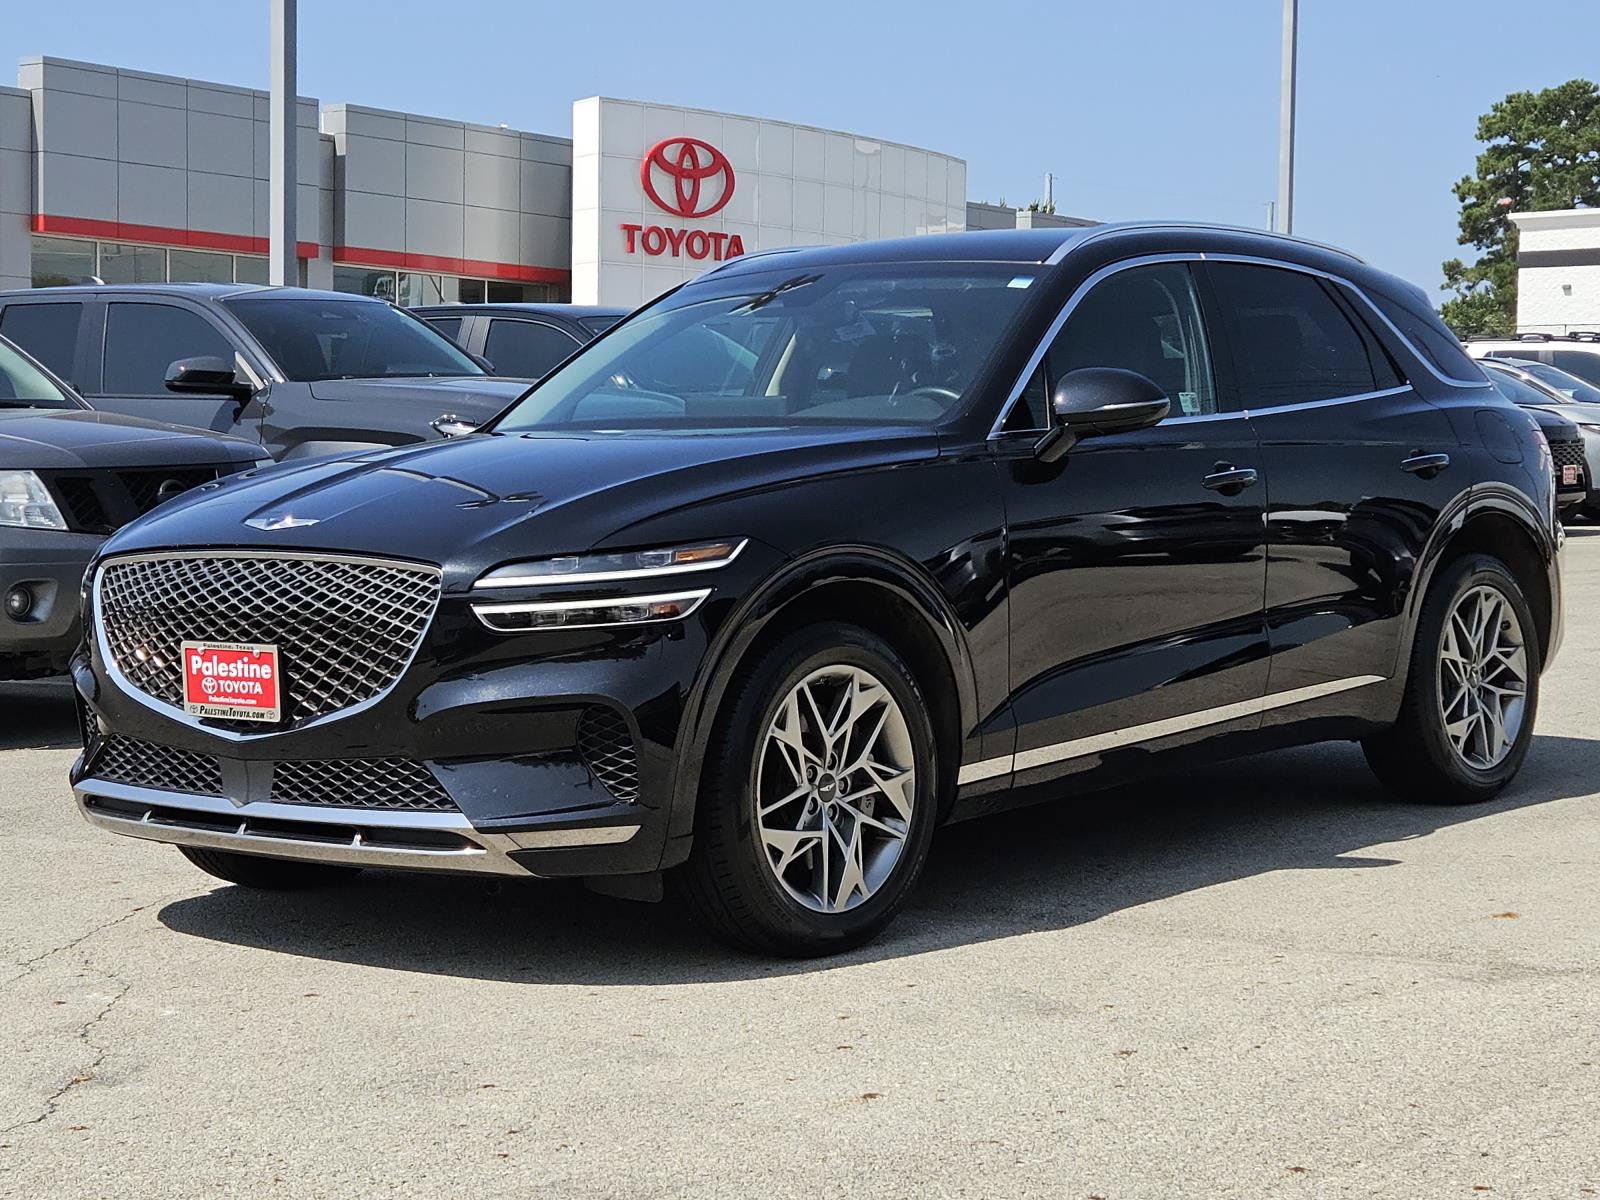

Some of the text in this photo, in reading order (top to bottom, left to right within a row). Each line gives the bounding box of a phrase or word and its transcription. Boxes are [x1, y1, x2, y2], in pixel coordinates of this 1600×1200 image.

[620, 223, 744, 261] TOYOTA
[191, 655, 272, 679] Palestine
[218, 680, 263, 695] TOYOTA
